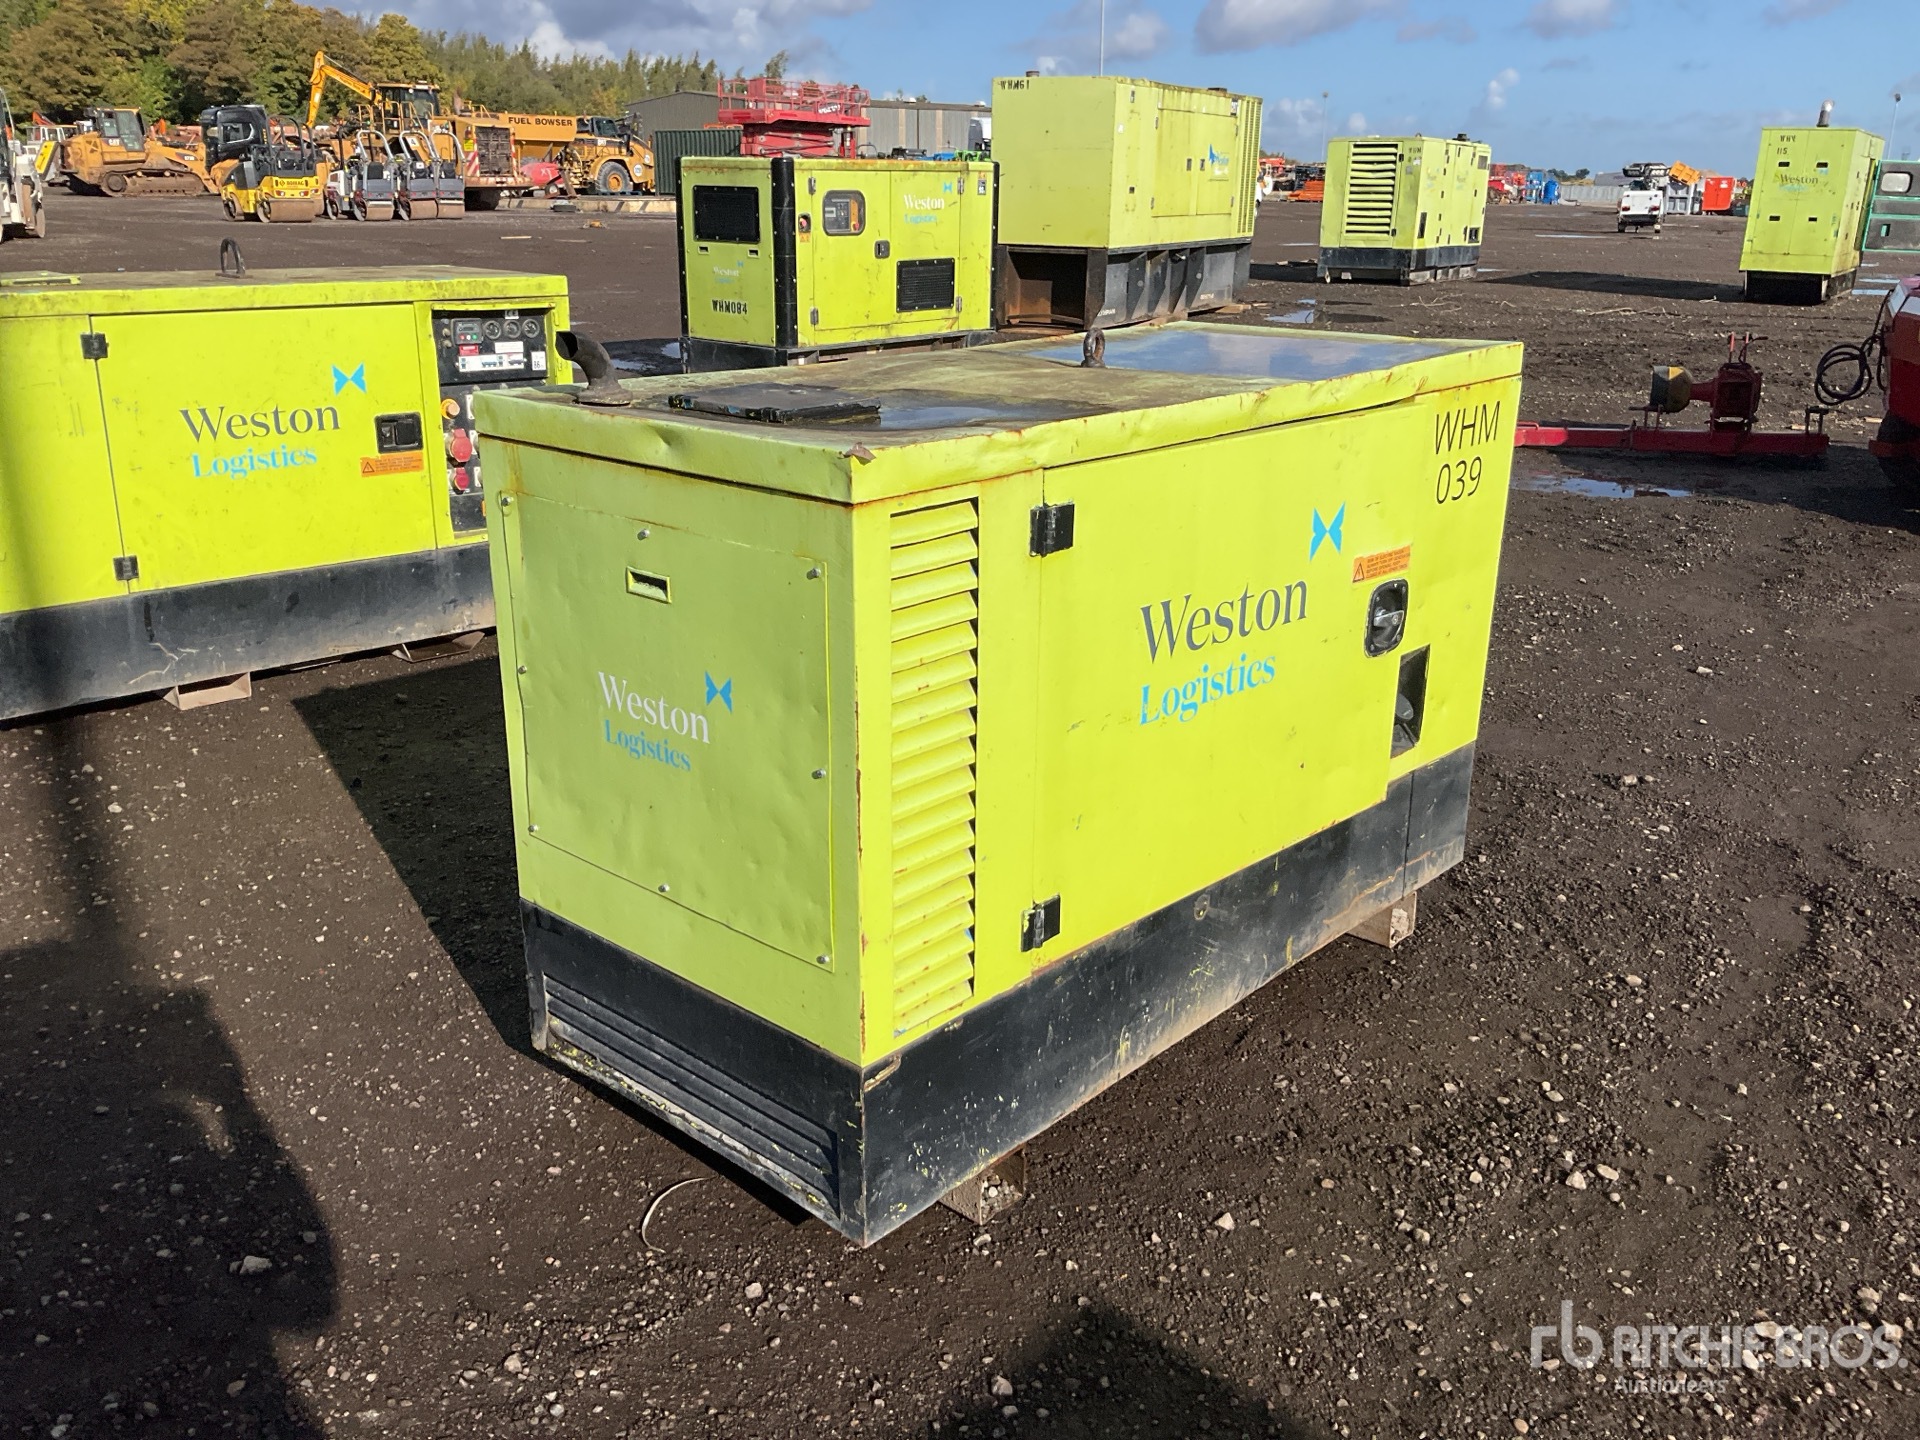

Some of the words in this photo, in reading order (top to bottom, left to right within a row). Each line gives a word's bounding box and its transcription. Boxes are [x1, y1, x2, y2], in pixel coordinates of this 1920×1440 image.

[508, 116, 531, 125] FUEL
[535, 118, 573, 127] BOWSER
[904, 194, 945, 210] Weston
[711, 299, 748, 315] WHM084
[180, 402, 341, 443] Weston
[1435, 400, 1501, 456] WHM
[192, 444, 319, 479] Logistics
[1436, 456, 1483, 505] 039
[1140, 578, 1309, 664] Weston
[598, 671, 711, 744] Weston
[1140, 652, 1277, 727] Logistics
[604, 719, 691, 772] Logistics
